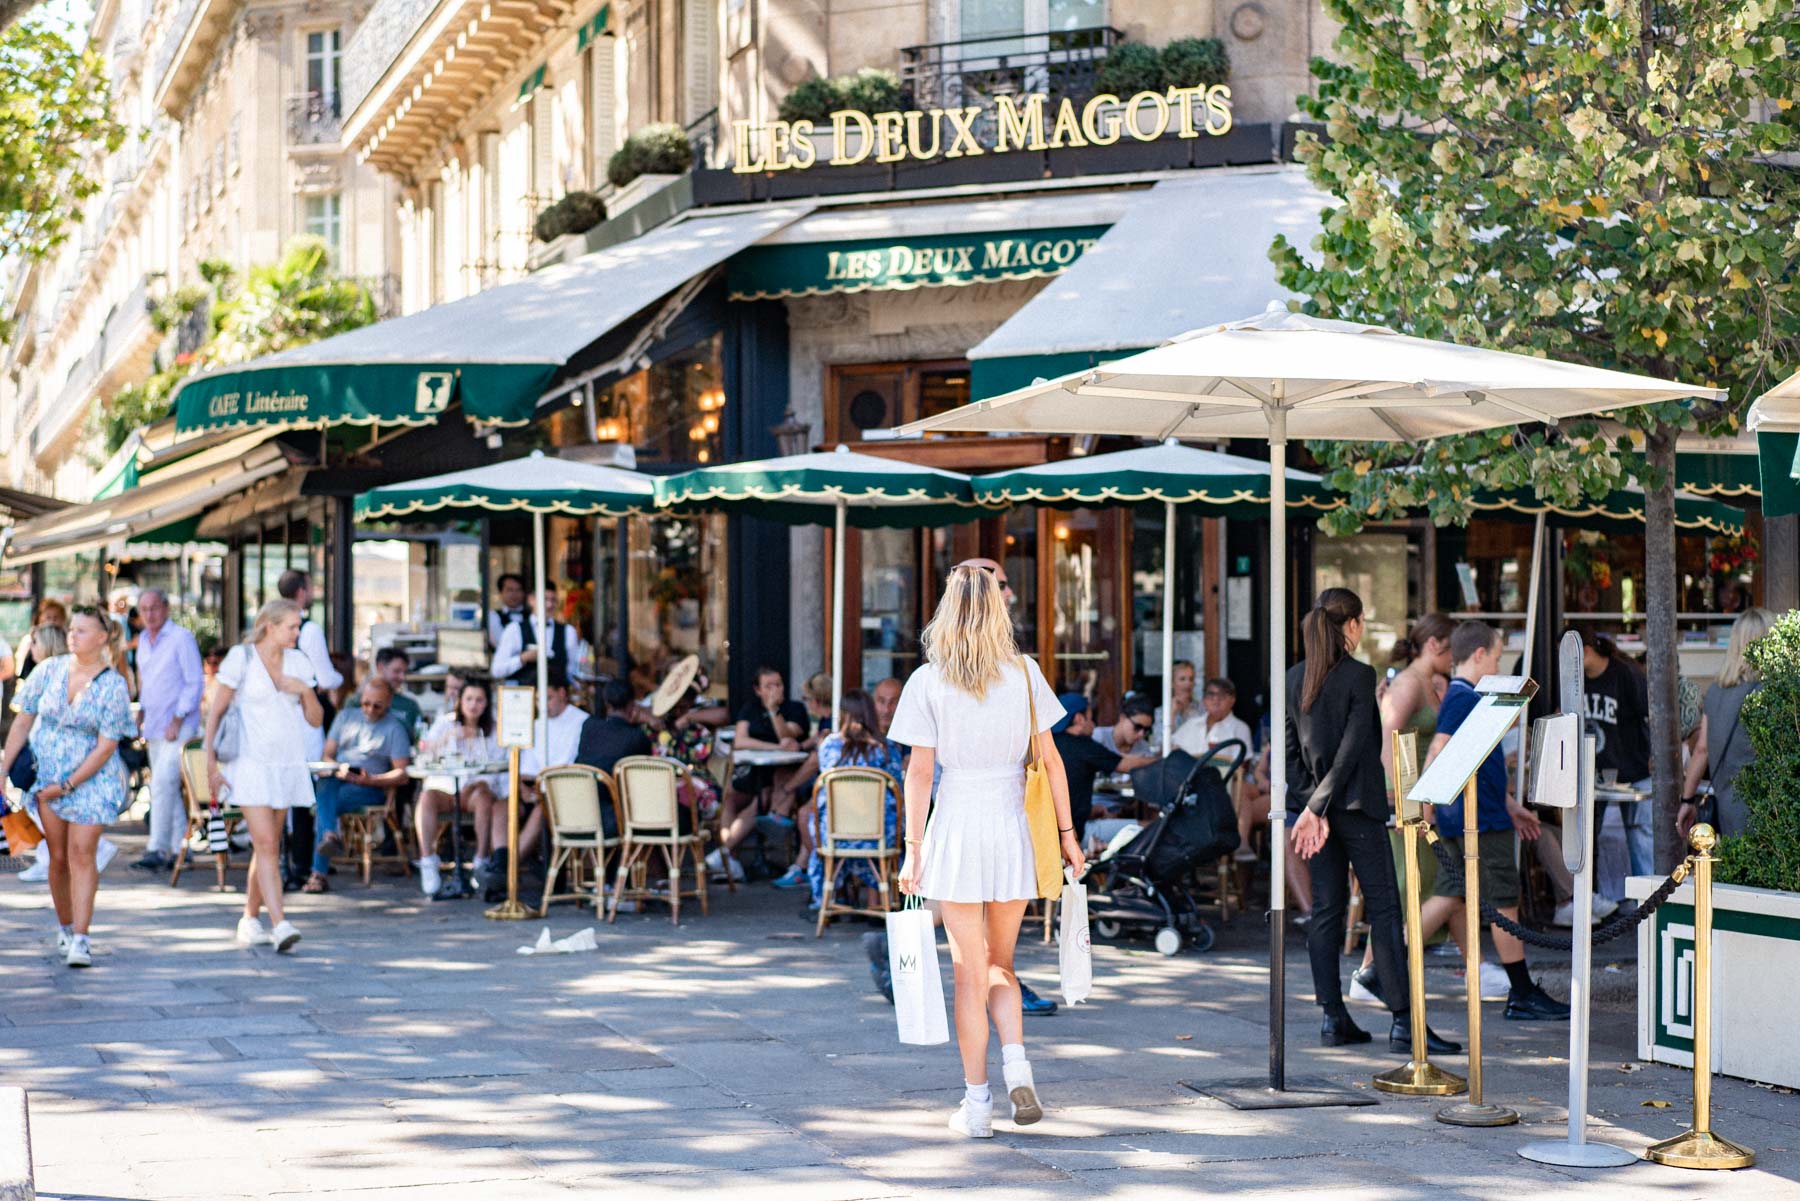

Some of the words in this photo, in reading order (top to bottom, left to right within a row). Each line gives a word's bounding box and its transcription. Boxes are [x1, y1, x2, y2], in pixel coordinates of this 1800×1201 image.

[732, 119, 816, 174] LES
[829, 106, 984, 166] DEUX
[993, 83, 1233, 153] MAGOTS
[826, 251, 882, 280] LES
[886, 245, 976, 277] DEUX
[981, 238, 1097, 270] MAGOT
[246, 389, 308, 413] Littéraire
[1583, 693, 1618, 725] ALE
